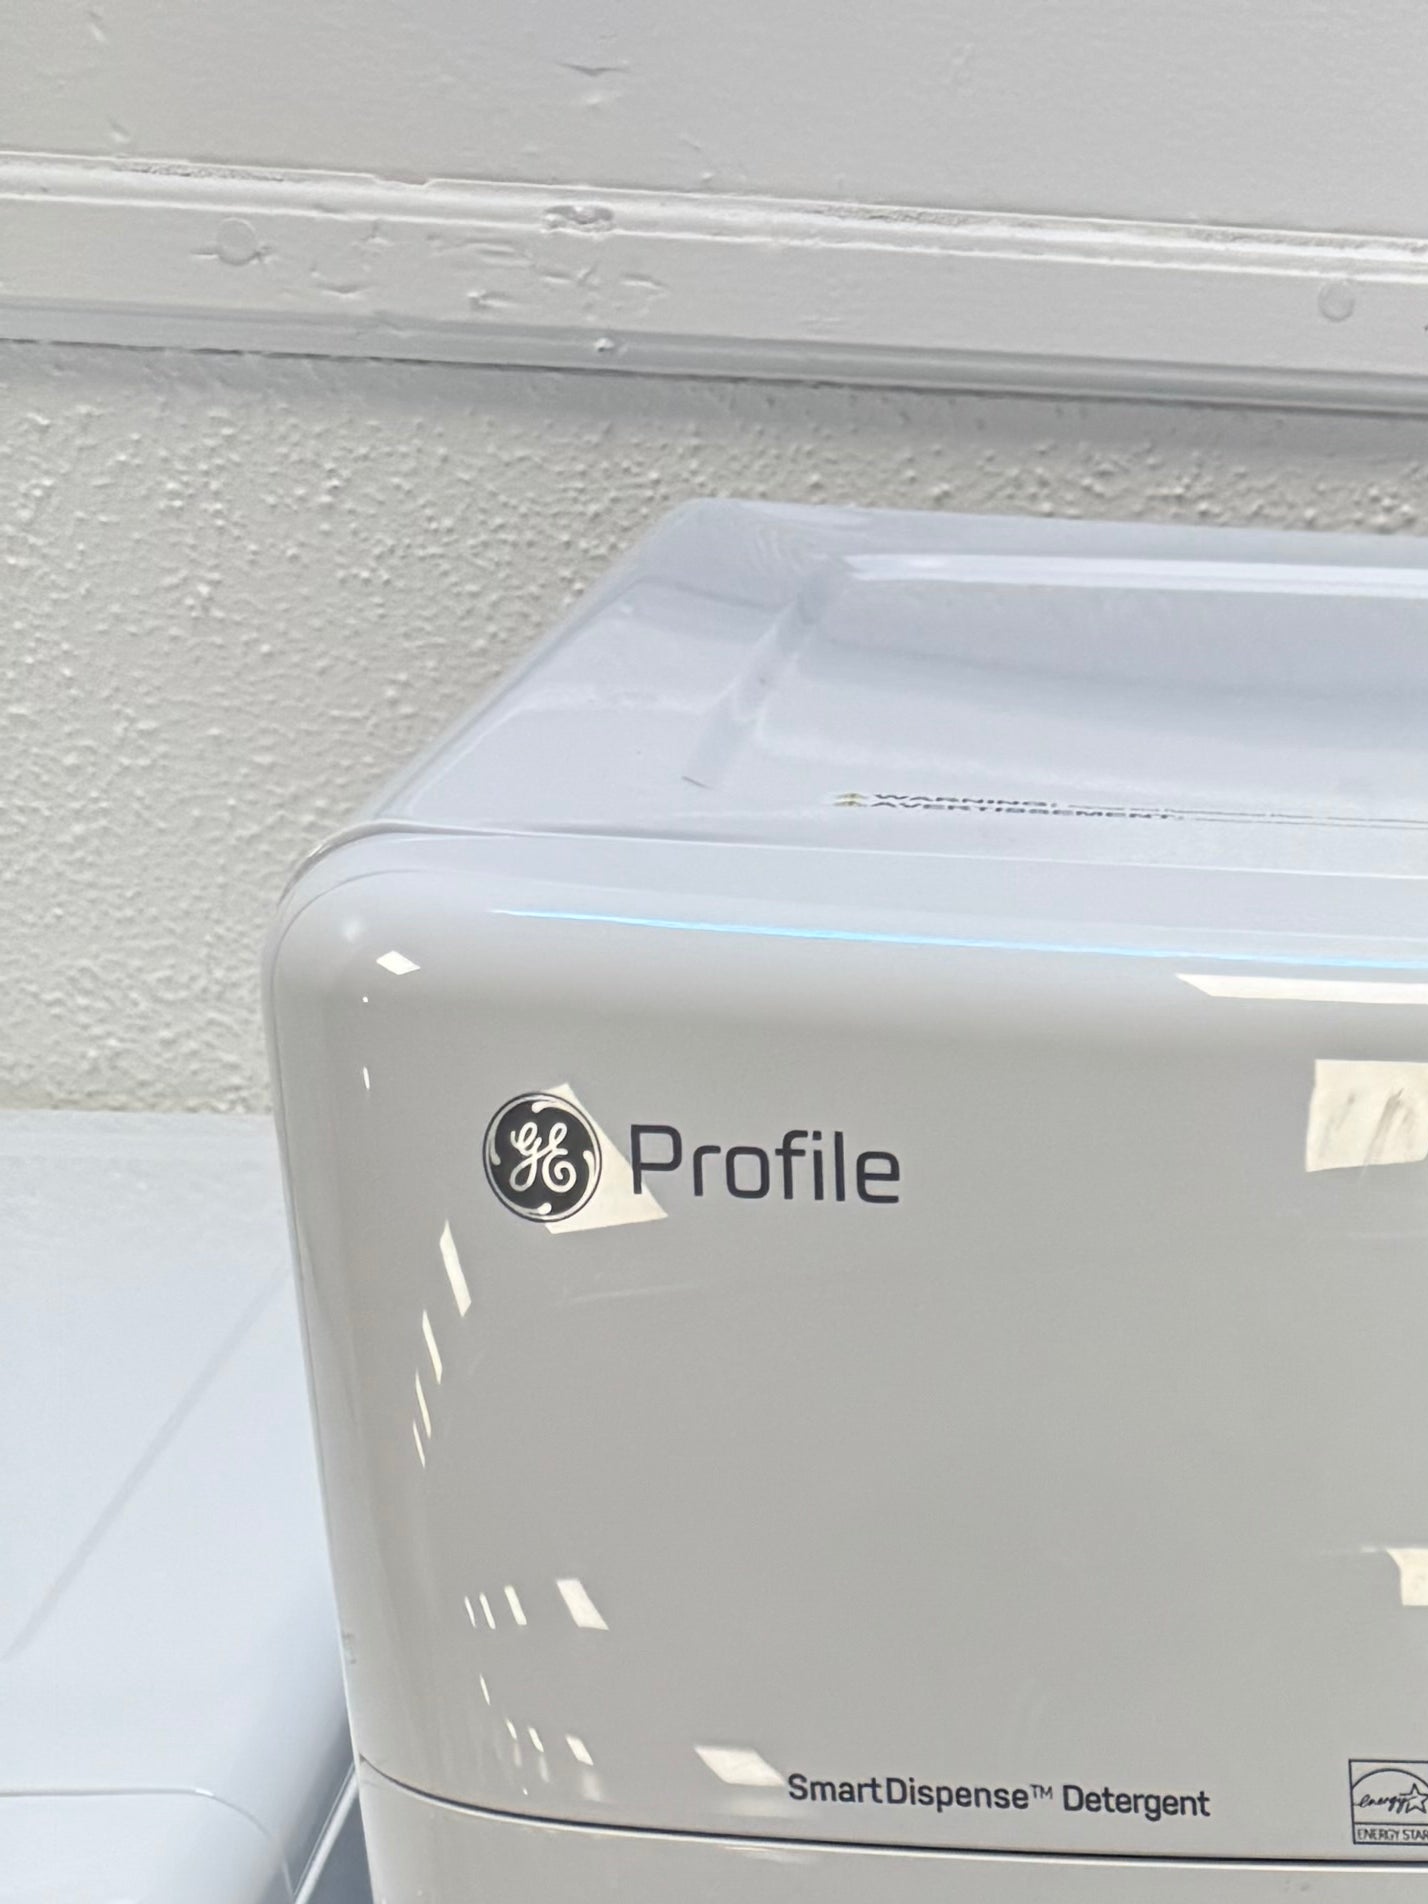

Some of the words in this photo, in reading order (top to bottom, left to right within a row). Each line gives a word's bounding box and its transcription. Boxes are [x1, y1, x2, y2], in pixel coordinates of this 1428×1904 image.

[630, 1123, 901, 1204] Profile
[1063, 1784, 1212, 1822] Detergent
[1356, 1828, 1400, 1841] ENERGY
